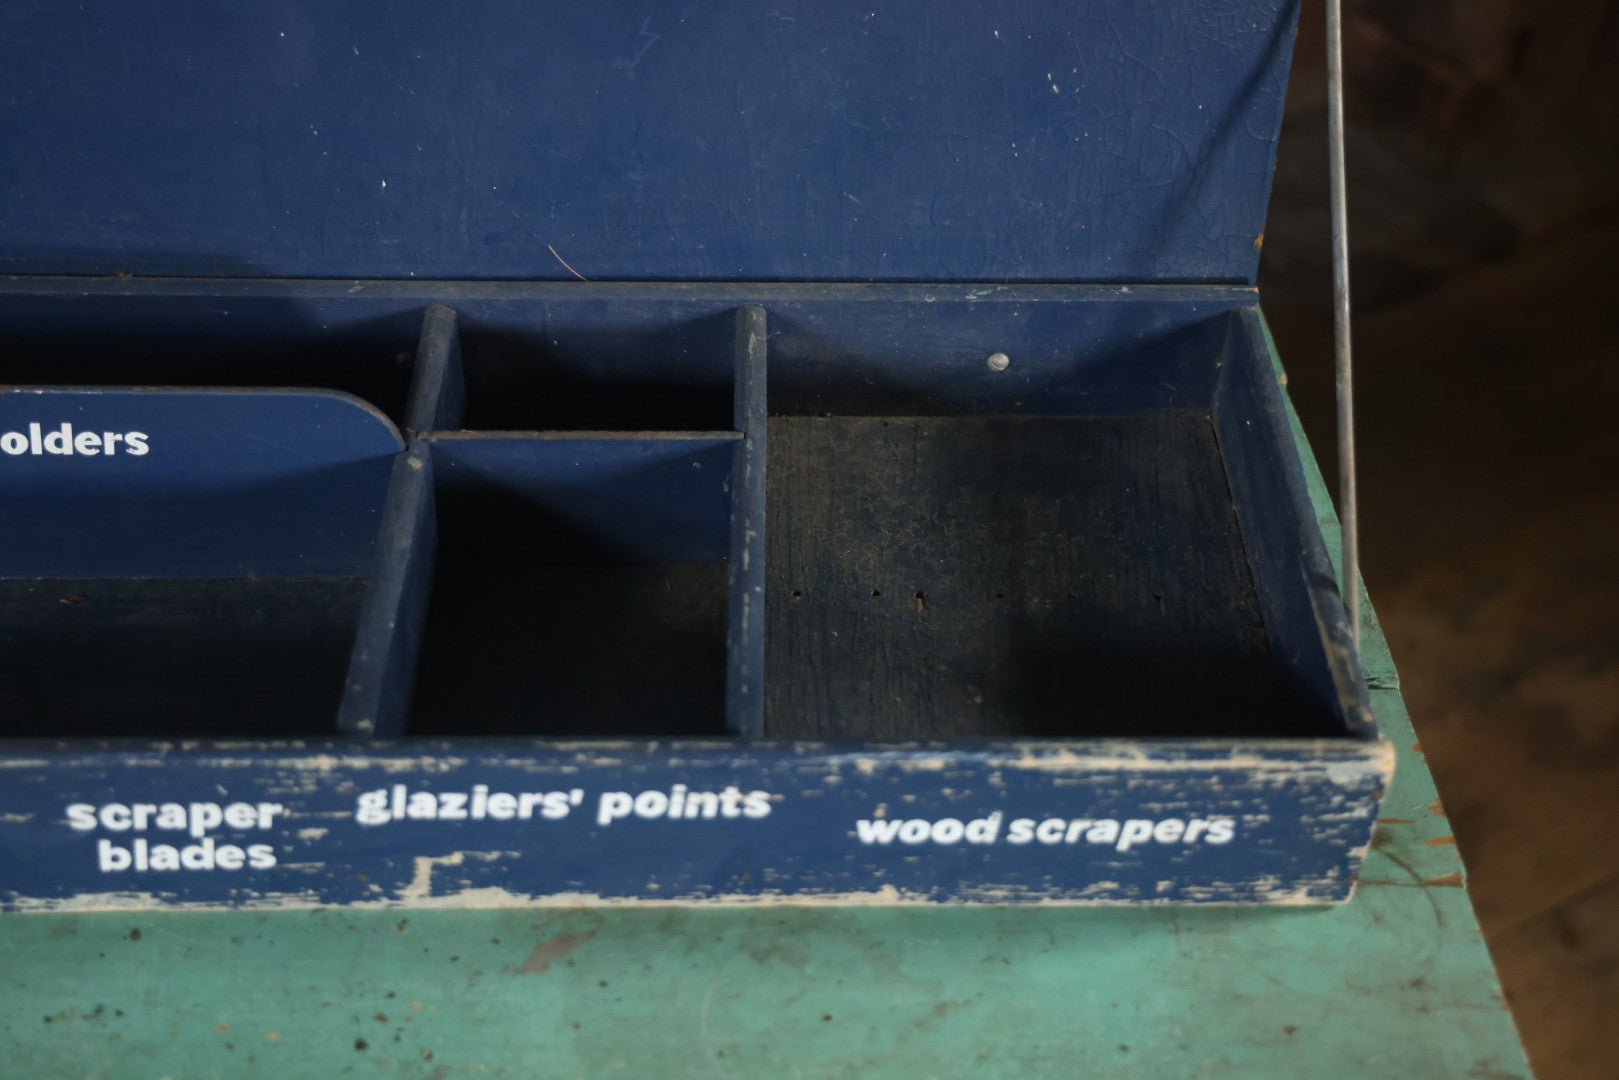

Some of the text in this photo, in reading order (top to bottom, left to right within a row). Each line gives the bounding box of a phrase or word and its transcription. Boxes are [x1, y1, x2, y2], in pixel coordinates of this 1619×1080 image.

[0, 422, 150, 456] olders
[65, 801, 284, 838] scraper
[355, 783, 773, 826] glaziers' points
[855, 810, 1237, 852] wood scrapers
[97, 838, 278, 873] blades
